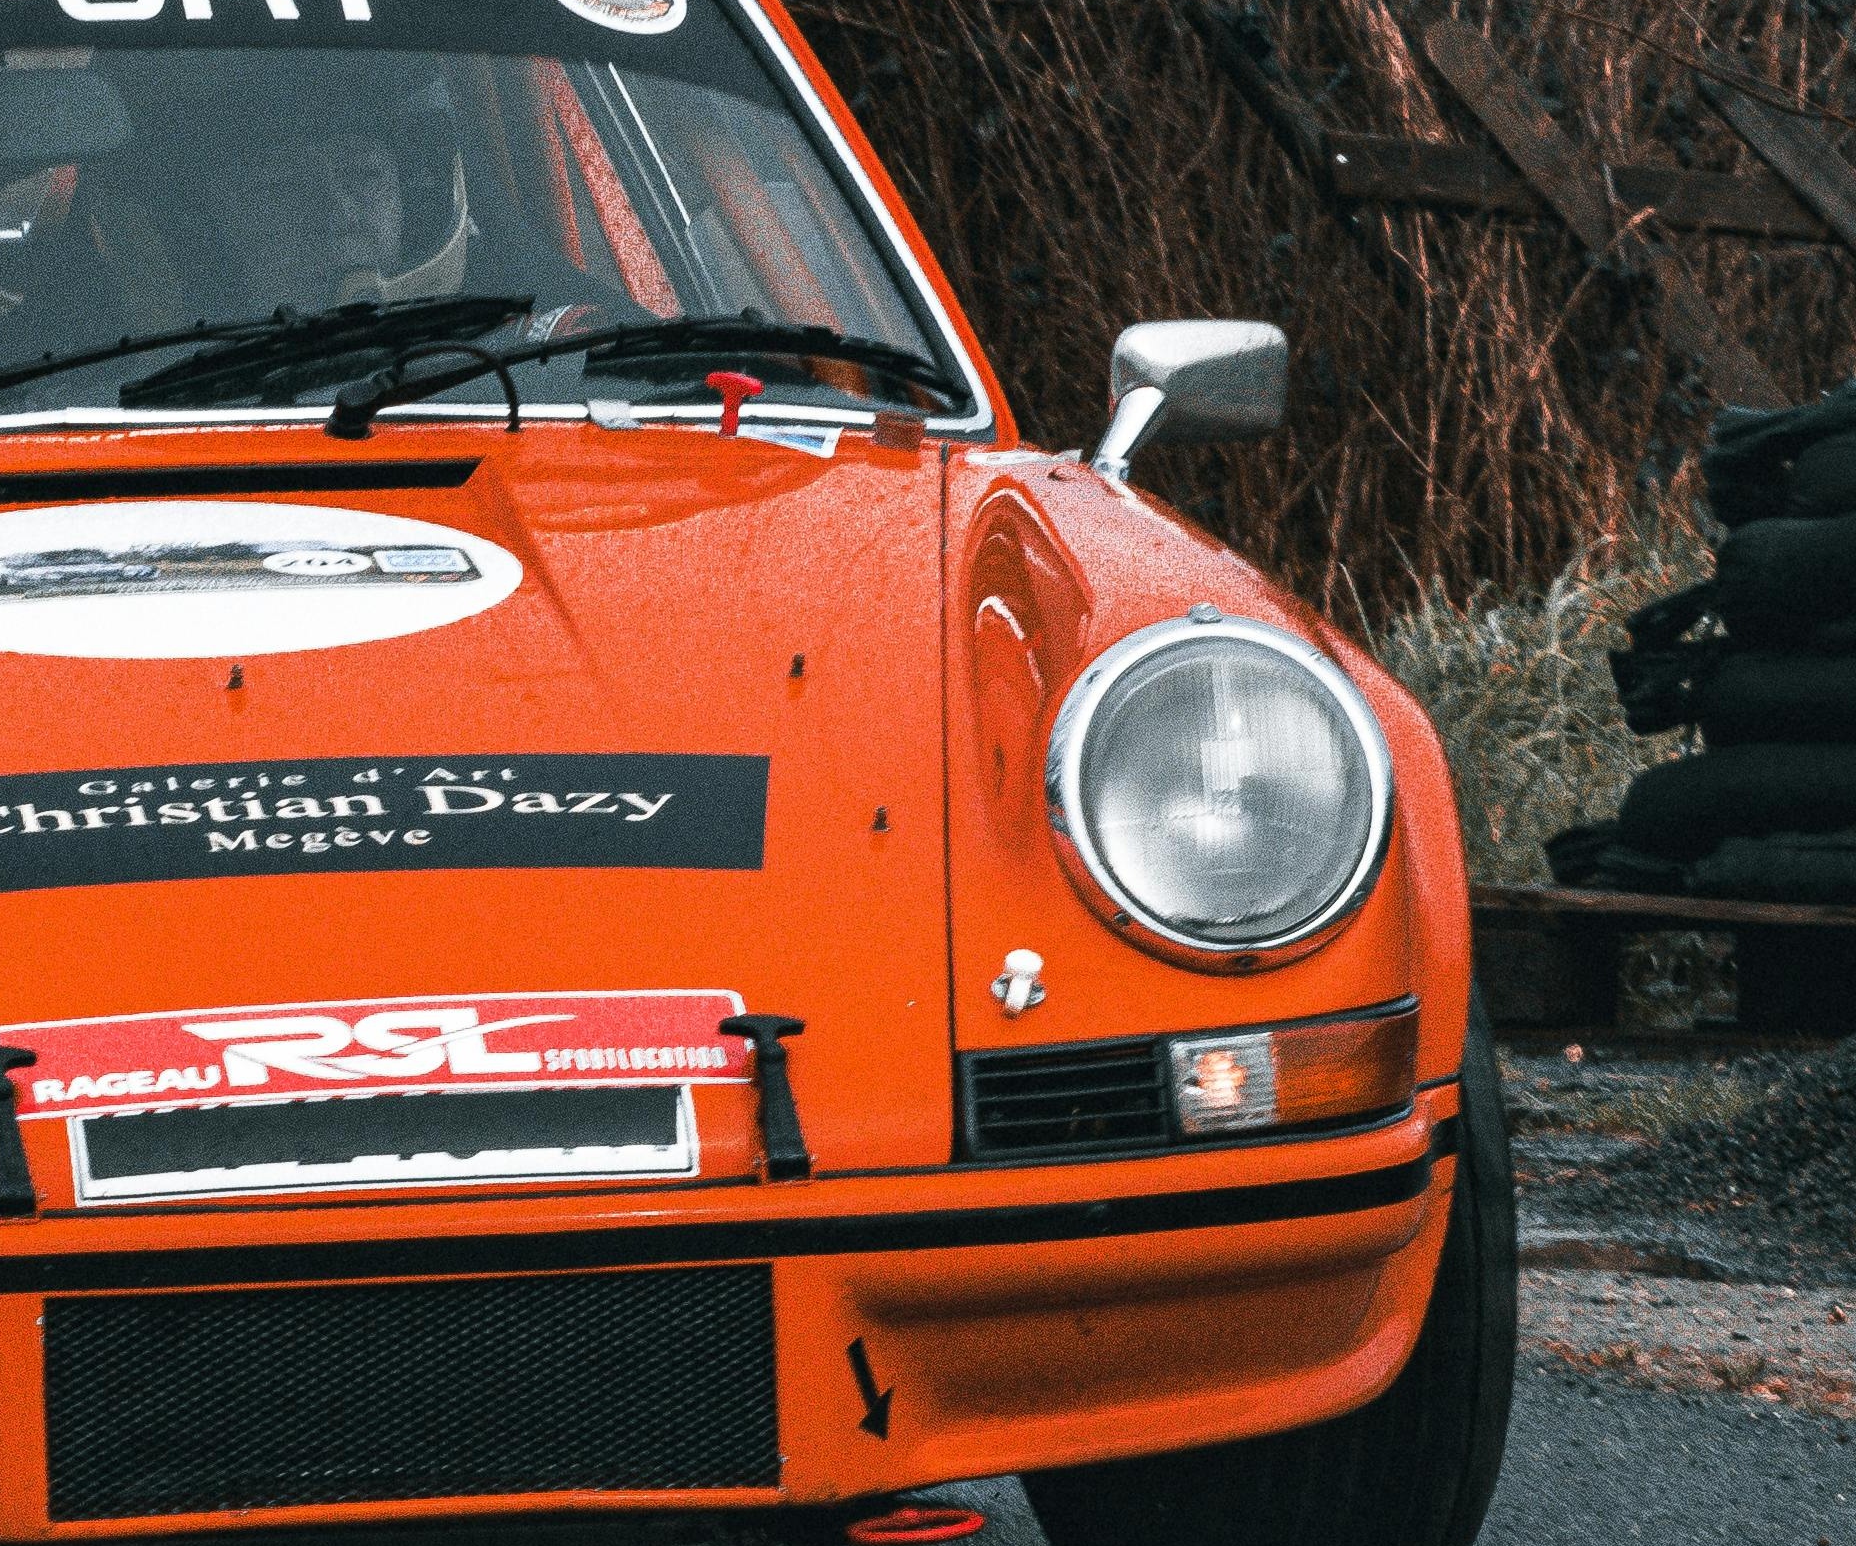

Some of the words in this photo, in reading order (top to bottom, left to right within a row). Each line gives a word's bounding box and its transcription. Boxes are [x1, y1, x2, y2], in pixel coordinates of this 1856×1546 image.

[77, 771, 308, 796] Galerie
[414, 784, 678, 822] Dazy
[205, 824, 433, 854] Megève
[31, 1064, 221, 1104] RAGEAU
